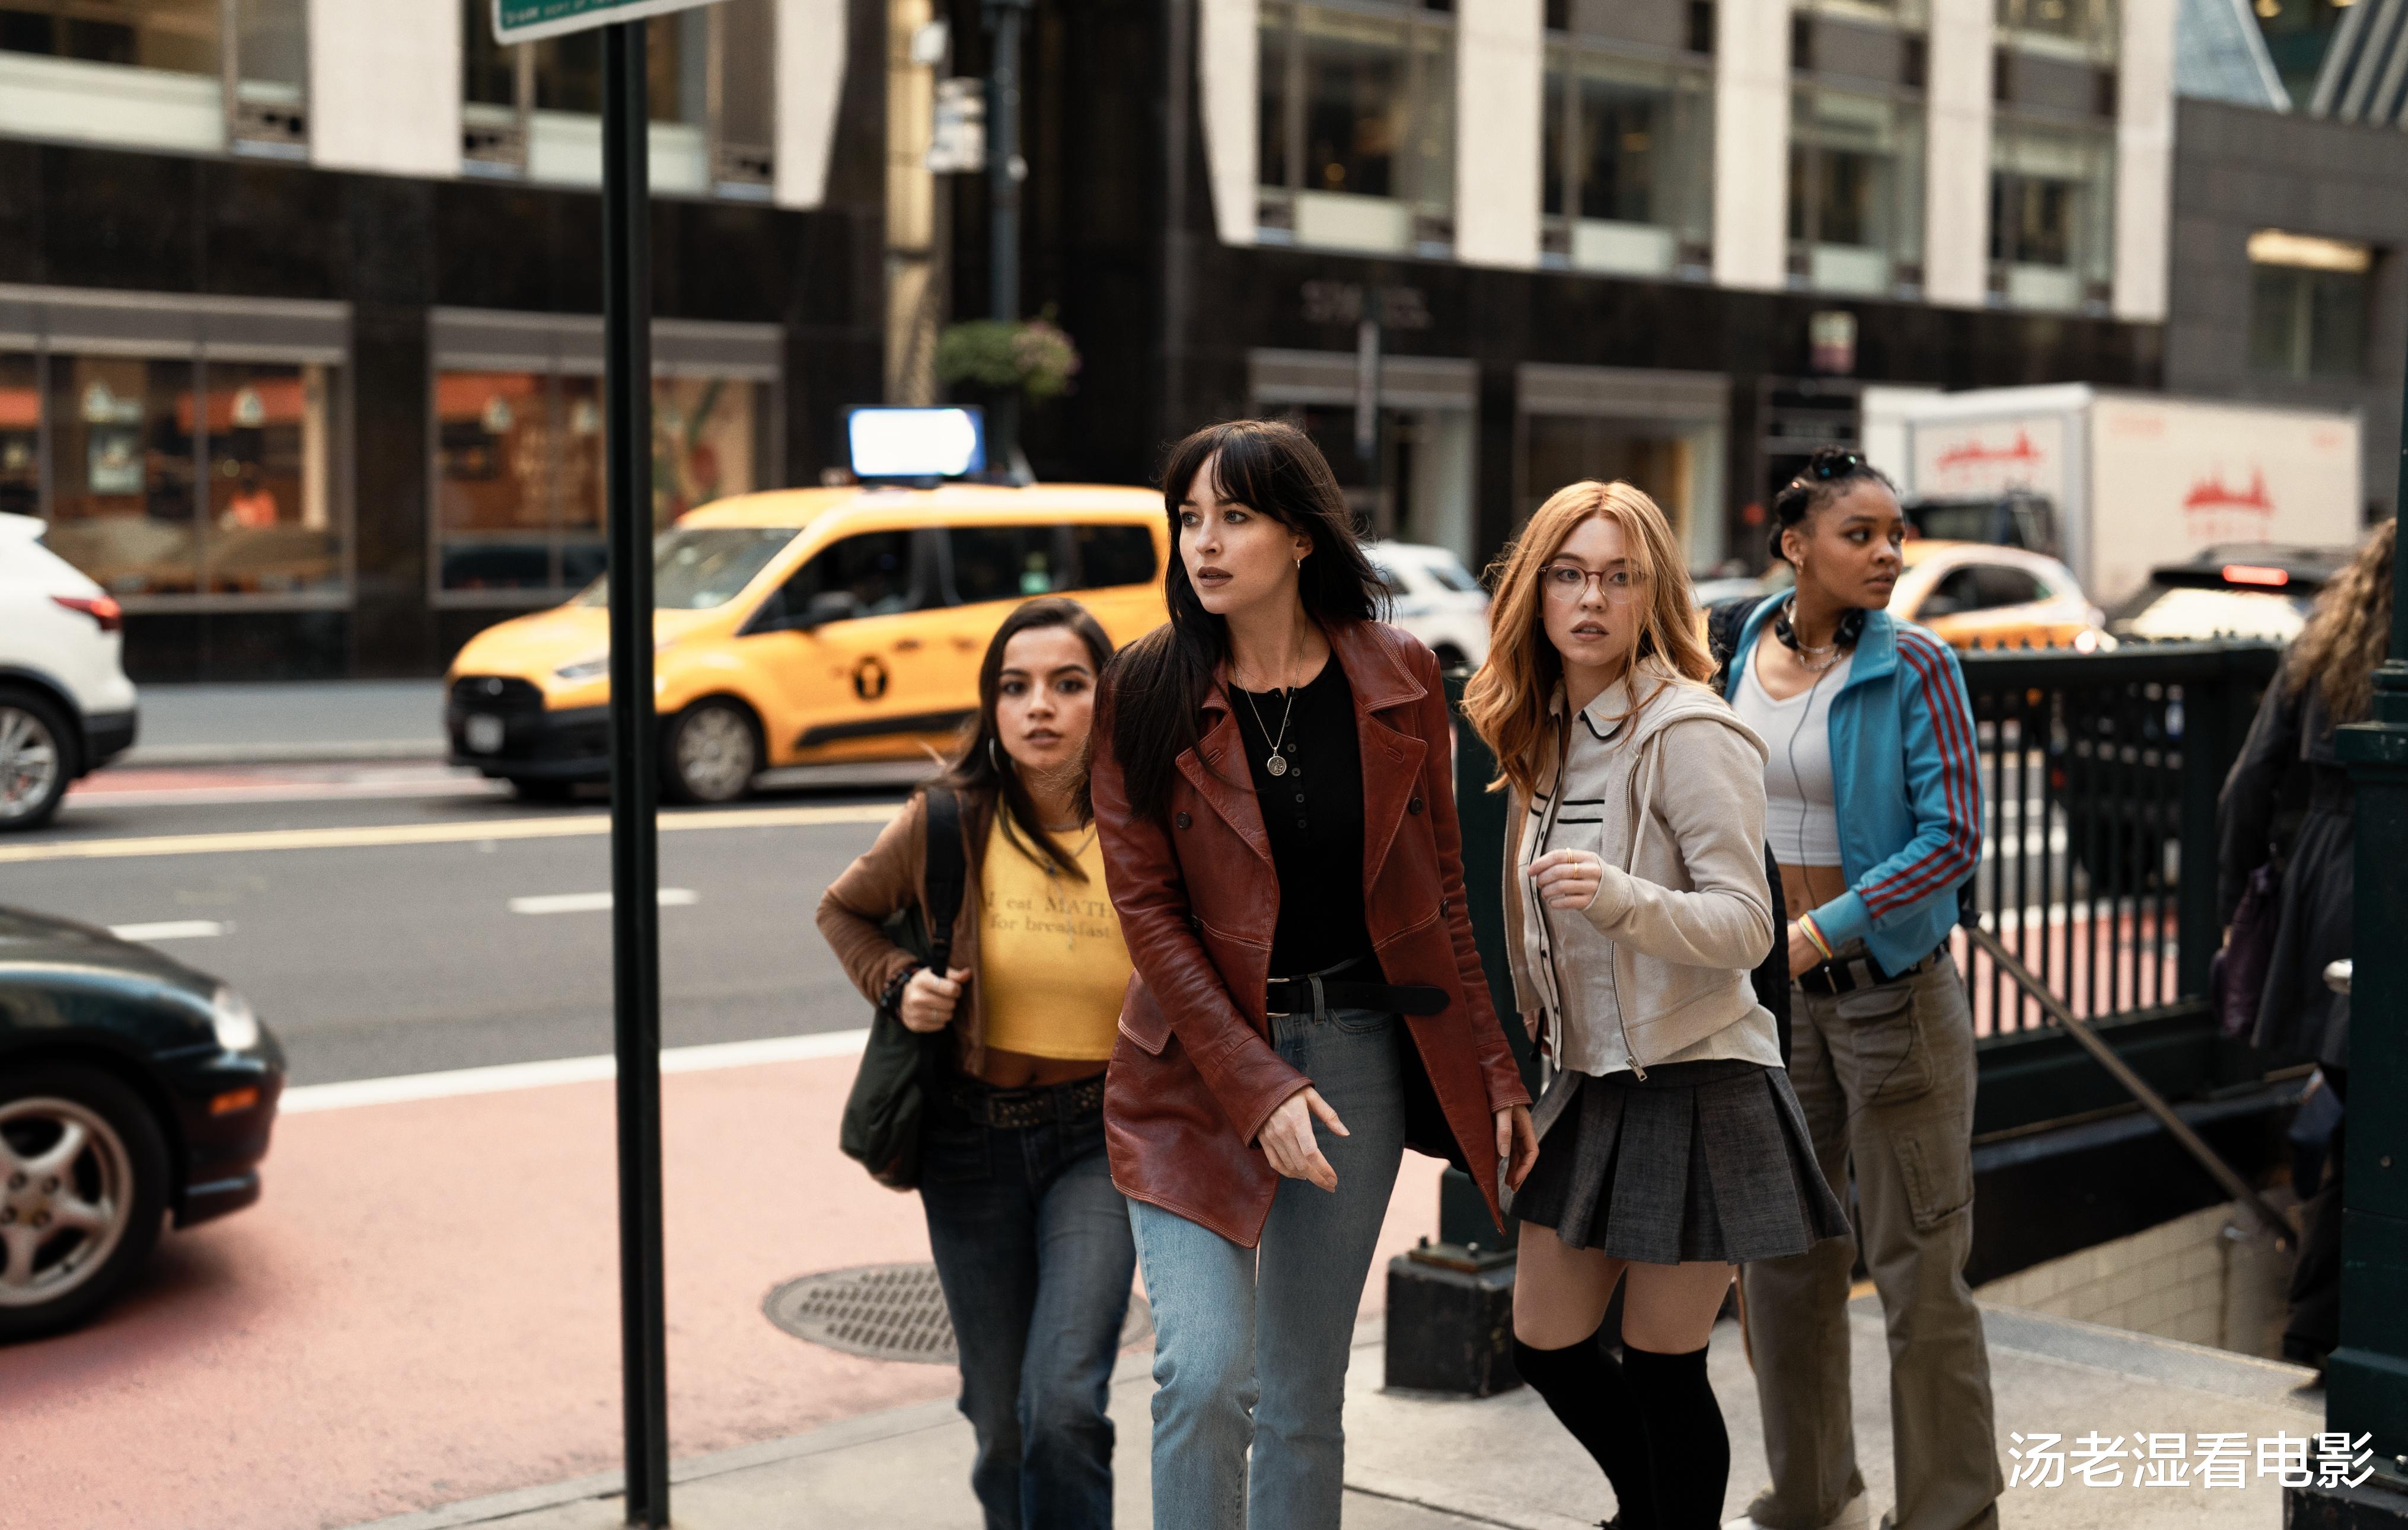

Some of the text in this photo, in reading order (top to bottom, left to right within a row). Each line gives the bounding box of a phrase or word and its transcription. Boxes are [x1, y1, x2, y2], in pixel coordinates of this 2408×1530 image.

[1006, 896, 1032, 910] eat
[989, 913, 1110, 938] for breakfast
